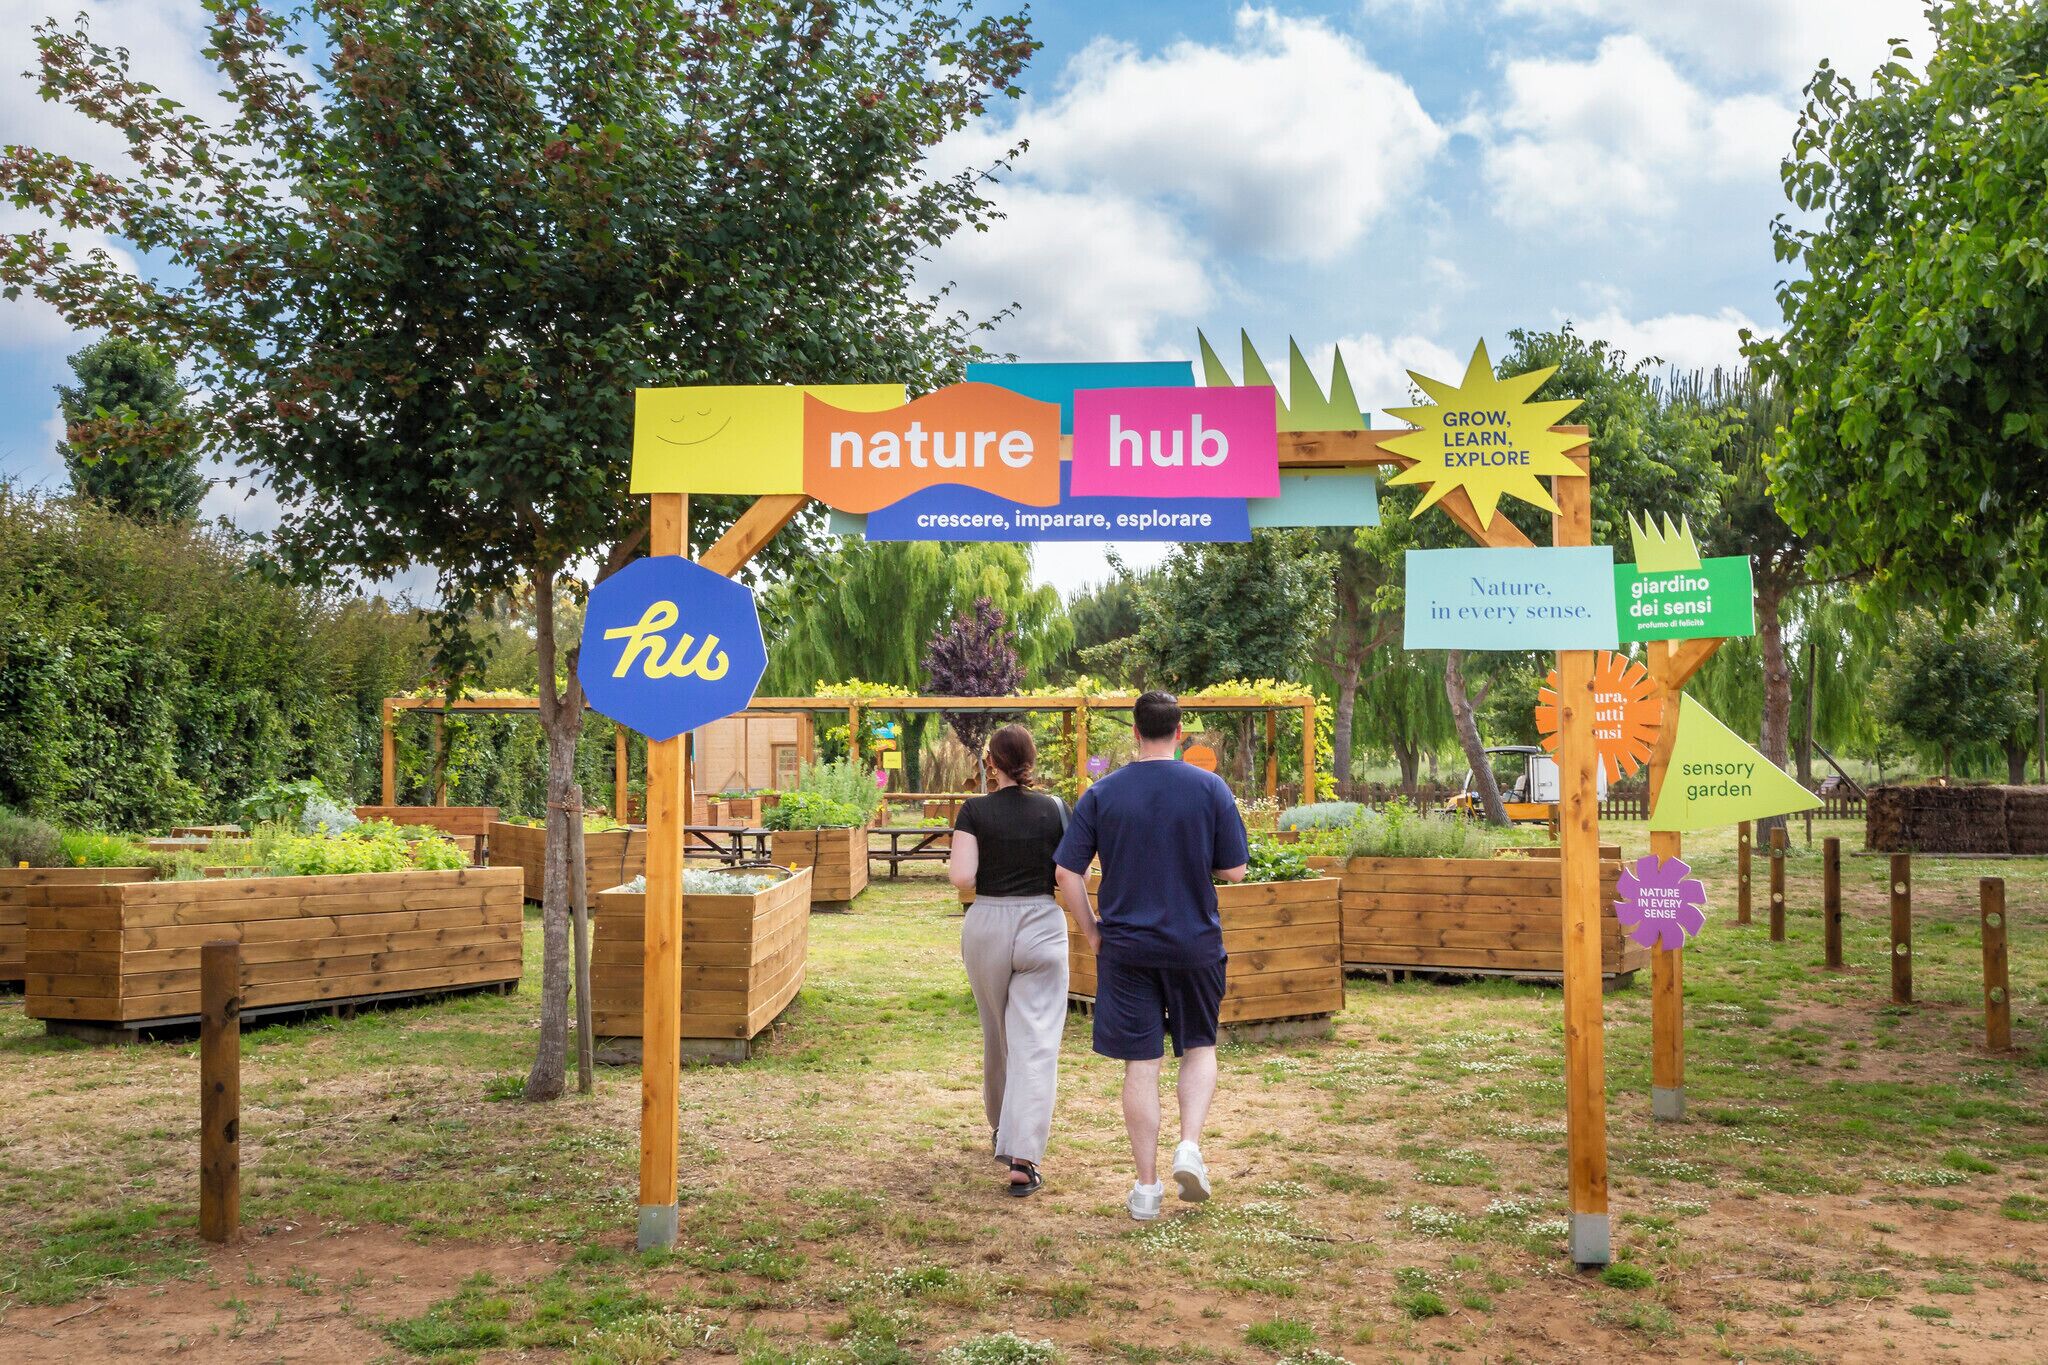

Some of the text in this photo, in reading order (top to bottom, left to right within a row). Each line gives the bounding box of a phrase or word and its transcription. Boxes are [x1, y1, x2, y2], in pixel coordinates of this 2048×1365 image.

[1443, 411, 1511, 428] GROW,
[831, 414, 1228, 468] nature hub
[1444, 431, 1513, 448] LEARN,
[1445, 451, 1530, 467] EXPLORE
[917, 509, 1212, 530] crescere, imparare, esplorare
[1631, 575, 1709, 599] giardino
[1431, 600, 1592, 624] in every sense.
[1630, 596, 1712, 617] dei sensi
[1637, 621, 1669, 631] profumo
[1670, 620, 1678, 628] di
[1594, 693, 1628, 705] ura,
[1595, 705, 1624, 722] utti
[1595, 724, 1622, 739] nsi
[1682, 762, 1755, 779] sensory
[1687, 779, 1752, 800] garden
[1639, 888, 1680, 898] NATURE
[1637, 898, 1682, 908] IN EVERY
[1644, 909, 1677, 919] SENSE
